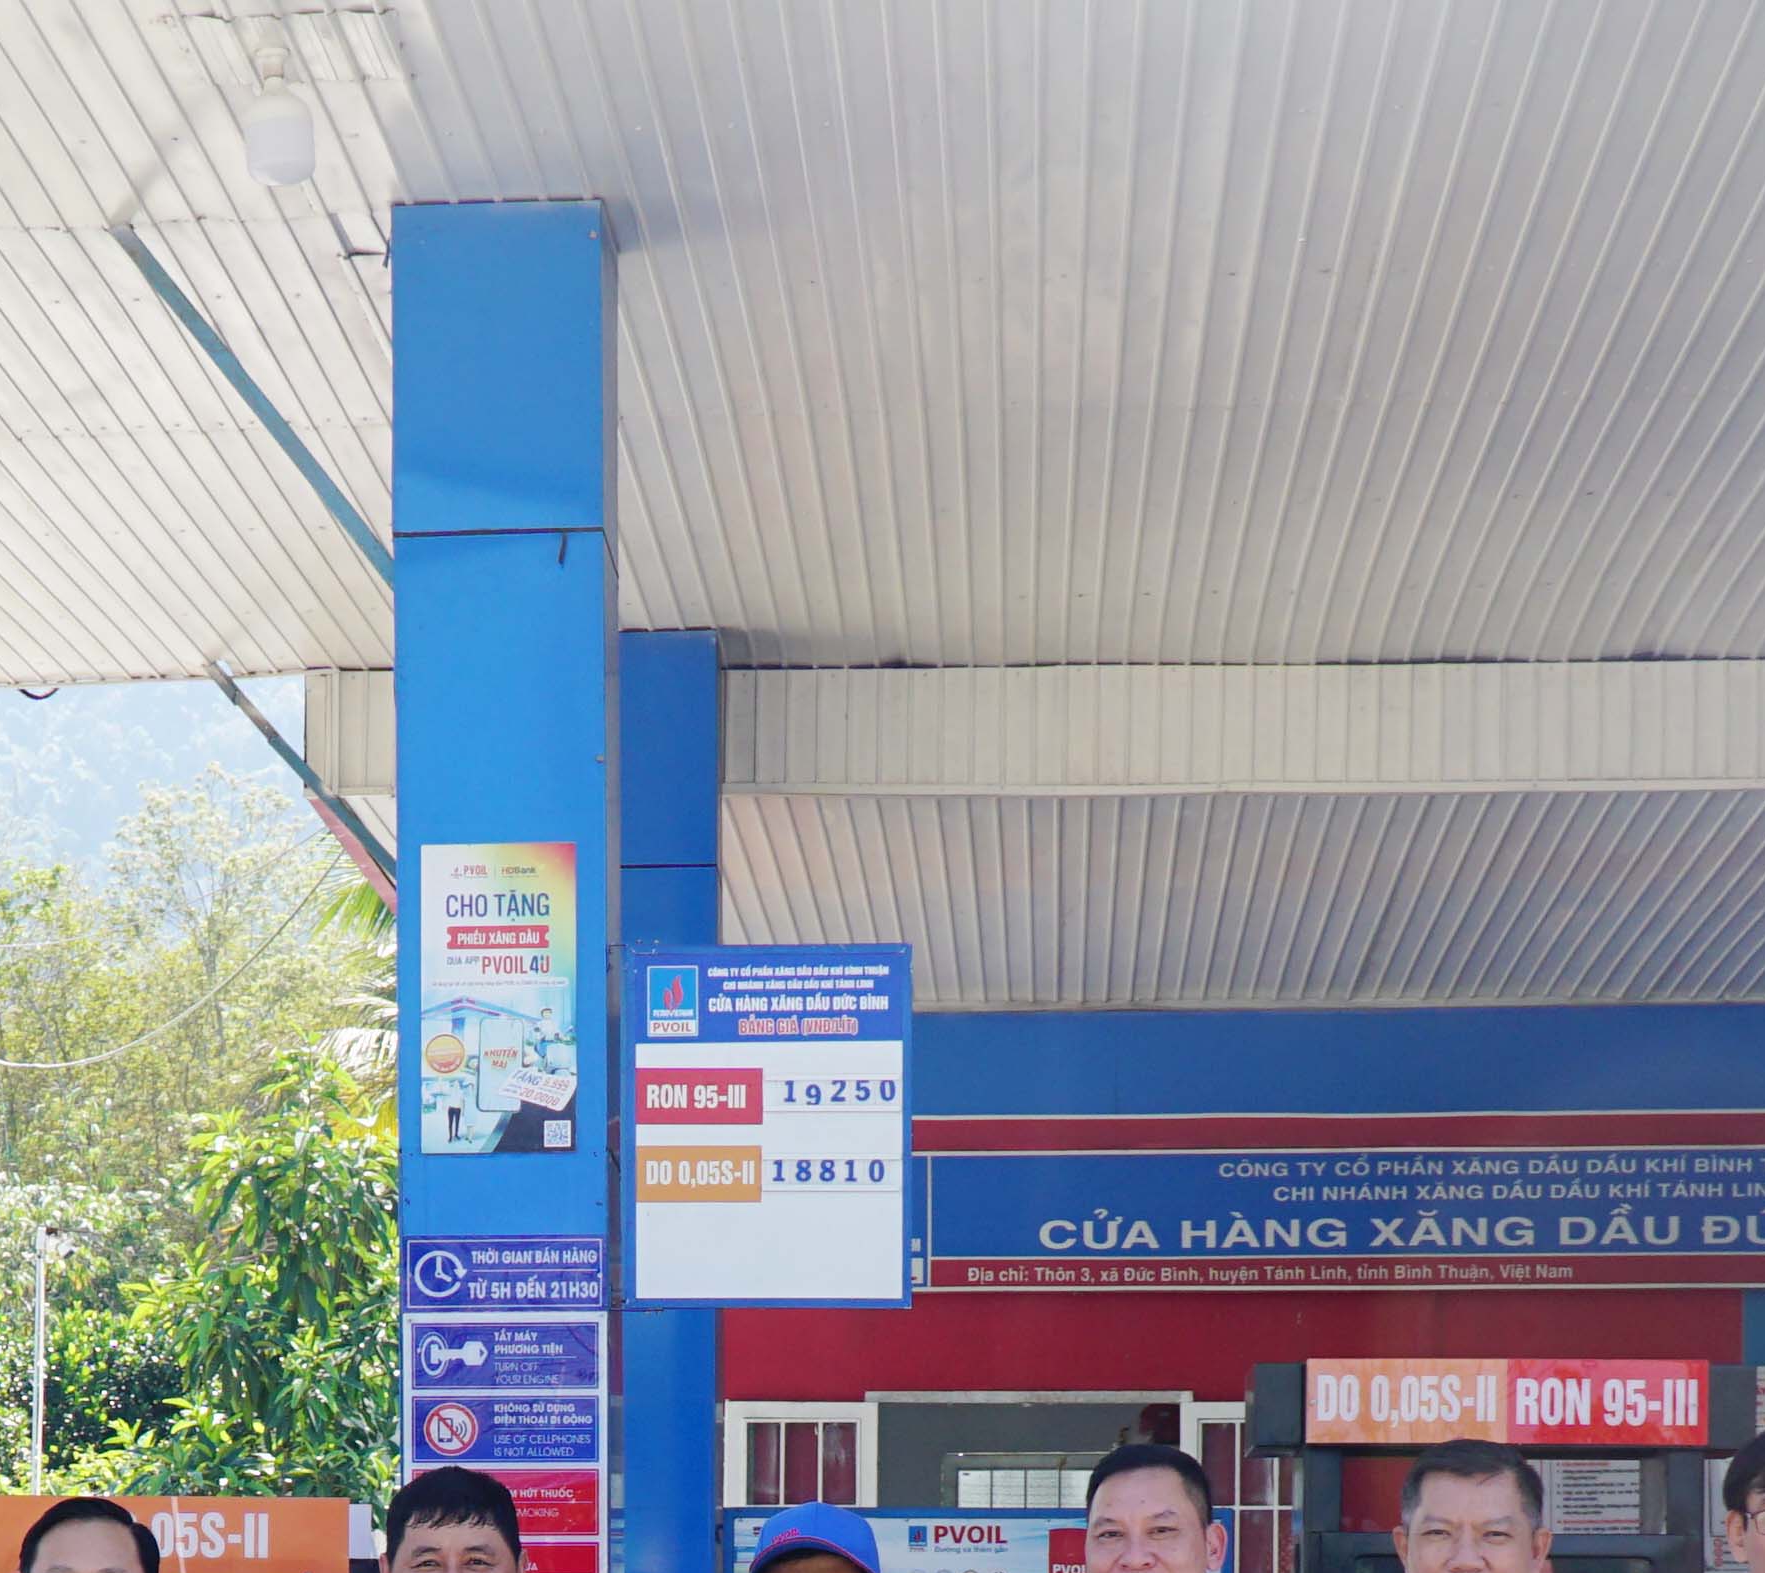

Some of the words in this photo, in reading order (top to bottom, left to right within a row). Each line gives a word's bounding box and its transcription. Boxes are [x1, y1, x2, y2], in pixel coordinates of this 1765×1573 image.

[464, 865, 488, 875] PVOIL
[446, 893, 488, 918] CHO
[493, 889, 551, 922] TẶNG
[457, 927, 486, 945] PHIẾU
[488, 928, 516, 945] XĂNG
[519, 927, 540, 944] DẦU
[708, 993, 733, 1012] CỬA
[735, 994, 768, 1011] HÀNG
[771, 993, 804, 1011] XĂNG
[806, 992, 830, 1011] DẦU
[859, 992, 889, 1010] BÌNH
[652, 1021, 693, 1033] PVOIL
[739, 1015, 774, 1036] BẢNG
[776, 1015, 799, 1035] GIÁ
[646, 1084, 688, 1109] RON
[692, 1084, 746, 1109] 95-III
[784, 1079, 897, 1106] 19250
[645, 1159, 674, 1185] DO
[678, 1159, 755, 1188] 0,05S-II
[772, 1159, 885, 1183] 18810
[1218, 1159, 1288, 1178] CÔNG
[1296, 1162, 1327, 1177] TY
[1334, 1153, 1370, 1177] CỔ
[1377, 1155, 1444, 1176] PHẦN
[1451, 1157, 1519, 1176] XĂNG
[1528, 1154, 1578, 1175] DẦU
[1586, 1154, 1636, 1174] DẦU
[1645, 1153, 1686, 1174] KHÍ
[1694, 1153, 1753, 1173] BÌNH
[1273, 1186, 1314, 1202] CHI
[1323, 1182, 1407, 1201] NHÁNH
[1415, 1182, 1484, 1200] XĂNG
[1492, 1179, 1541, 1200] DẦU
[1550, 1178, 1600, 1199] DẦU
[1609, 1179, 1652, 1198] KHÍ
[1656, 1179, 1724, 1198] TÁNH
[1038, 1208, 1160, 1250] CỬA
[1180, 1211, 1348, 1250] HÀNG
[1369, 1209, 1535, 1247] XĂNG
[1558, 1202, 1680, 1246] DẦU
[471, 1248, 499, 1265] THỜI
[502, 1250, 532, 1264] GIAN
[536, 1247, 560, 1264] BÁN
[562, 1247, 598, 1264] HÀNG
[967, 1266, 995, 1285] Địa
[998, 1264, 1029, 1283] chỉ:
[1034, 1266, 1076, 1283] Thôn
[1081, 1267, 1095, 1284] 3,
[1099, 1267, 1119, 1282] xã
[1123, 1266, 1156, 1283] Đức
[1161, 1266, 1204, 1284] Bình,
[1209, 1266, 1259, 1285] huyện
[1264, 1265, 1306, 1281] Tánh
[1357, 1262, 1389, 1280] tỉnh
[1394, 1264, 1433, 1280] Bình
[1438, 1264, 1494, 1281] Thuận,
[1499, 1263, 1531, 1281] Việt
[1536, 1264, 1574, 1279] Nam
[468, 1278, 488, 1299] TỪ
[491, 1282, 511, 1299] 5H
[515, 1275, 546, 1299] ĐẾN
[551, 1281, 599, 1299] 21H30
[494, 1328, 512, 1341] TẮT
[515, 1330, 538, 1341] MÁY
[494, 1343, 539, 1354] PHƯƠNG
[542, 1342, 563, 1356] TIỆN
[494, 1362, 519, 1372] TURN
[520, 1362, 538, 1371] OFF
[495, 1374, 521, 1384] YOUR
[523, 1374, 559, 1384] ENGINE
[494, 1402, 530, 1412] KHÔNG
[533, 1401, 545, 1412] SỬ
[547, 1403, 575, 1414] DỤNG
[1316, 1375, 1360, 1422] DO
[1370, 1374, 1497, 1428] 0,05S-II
[1515, 1378, 1591, 1427] RON
[1603, 1378, 1698, 1427] 95-III
[494, 1414, 516, 1426] ĐIỆN
[519, 1416, 548, 1426] THOẠI
[550, 1416, 561, 1424] DI
[563, 1414, 593, 1426] ĐỘNG
[494, 1435, 512, 1444] USE
[513, 1435, 528, 1444] OF
[529, 1434, 591, 1444] CELLPHONES
[504, 1447, 524, 1457] NOT
[527, 1447, 575, 1457] ALLOWED
[520, 1487, 538, 1498] HÚT
[540, 1486, 574, 1498] THUỐC
[934, 1525, 1008, 1545] PVOIL
